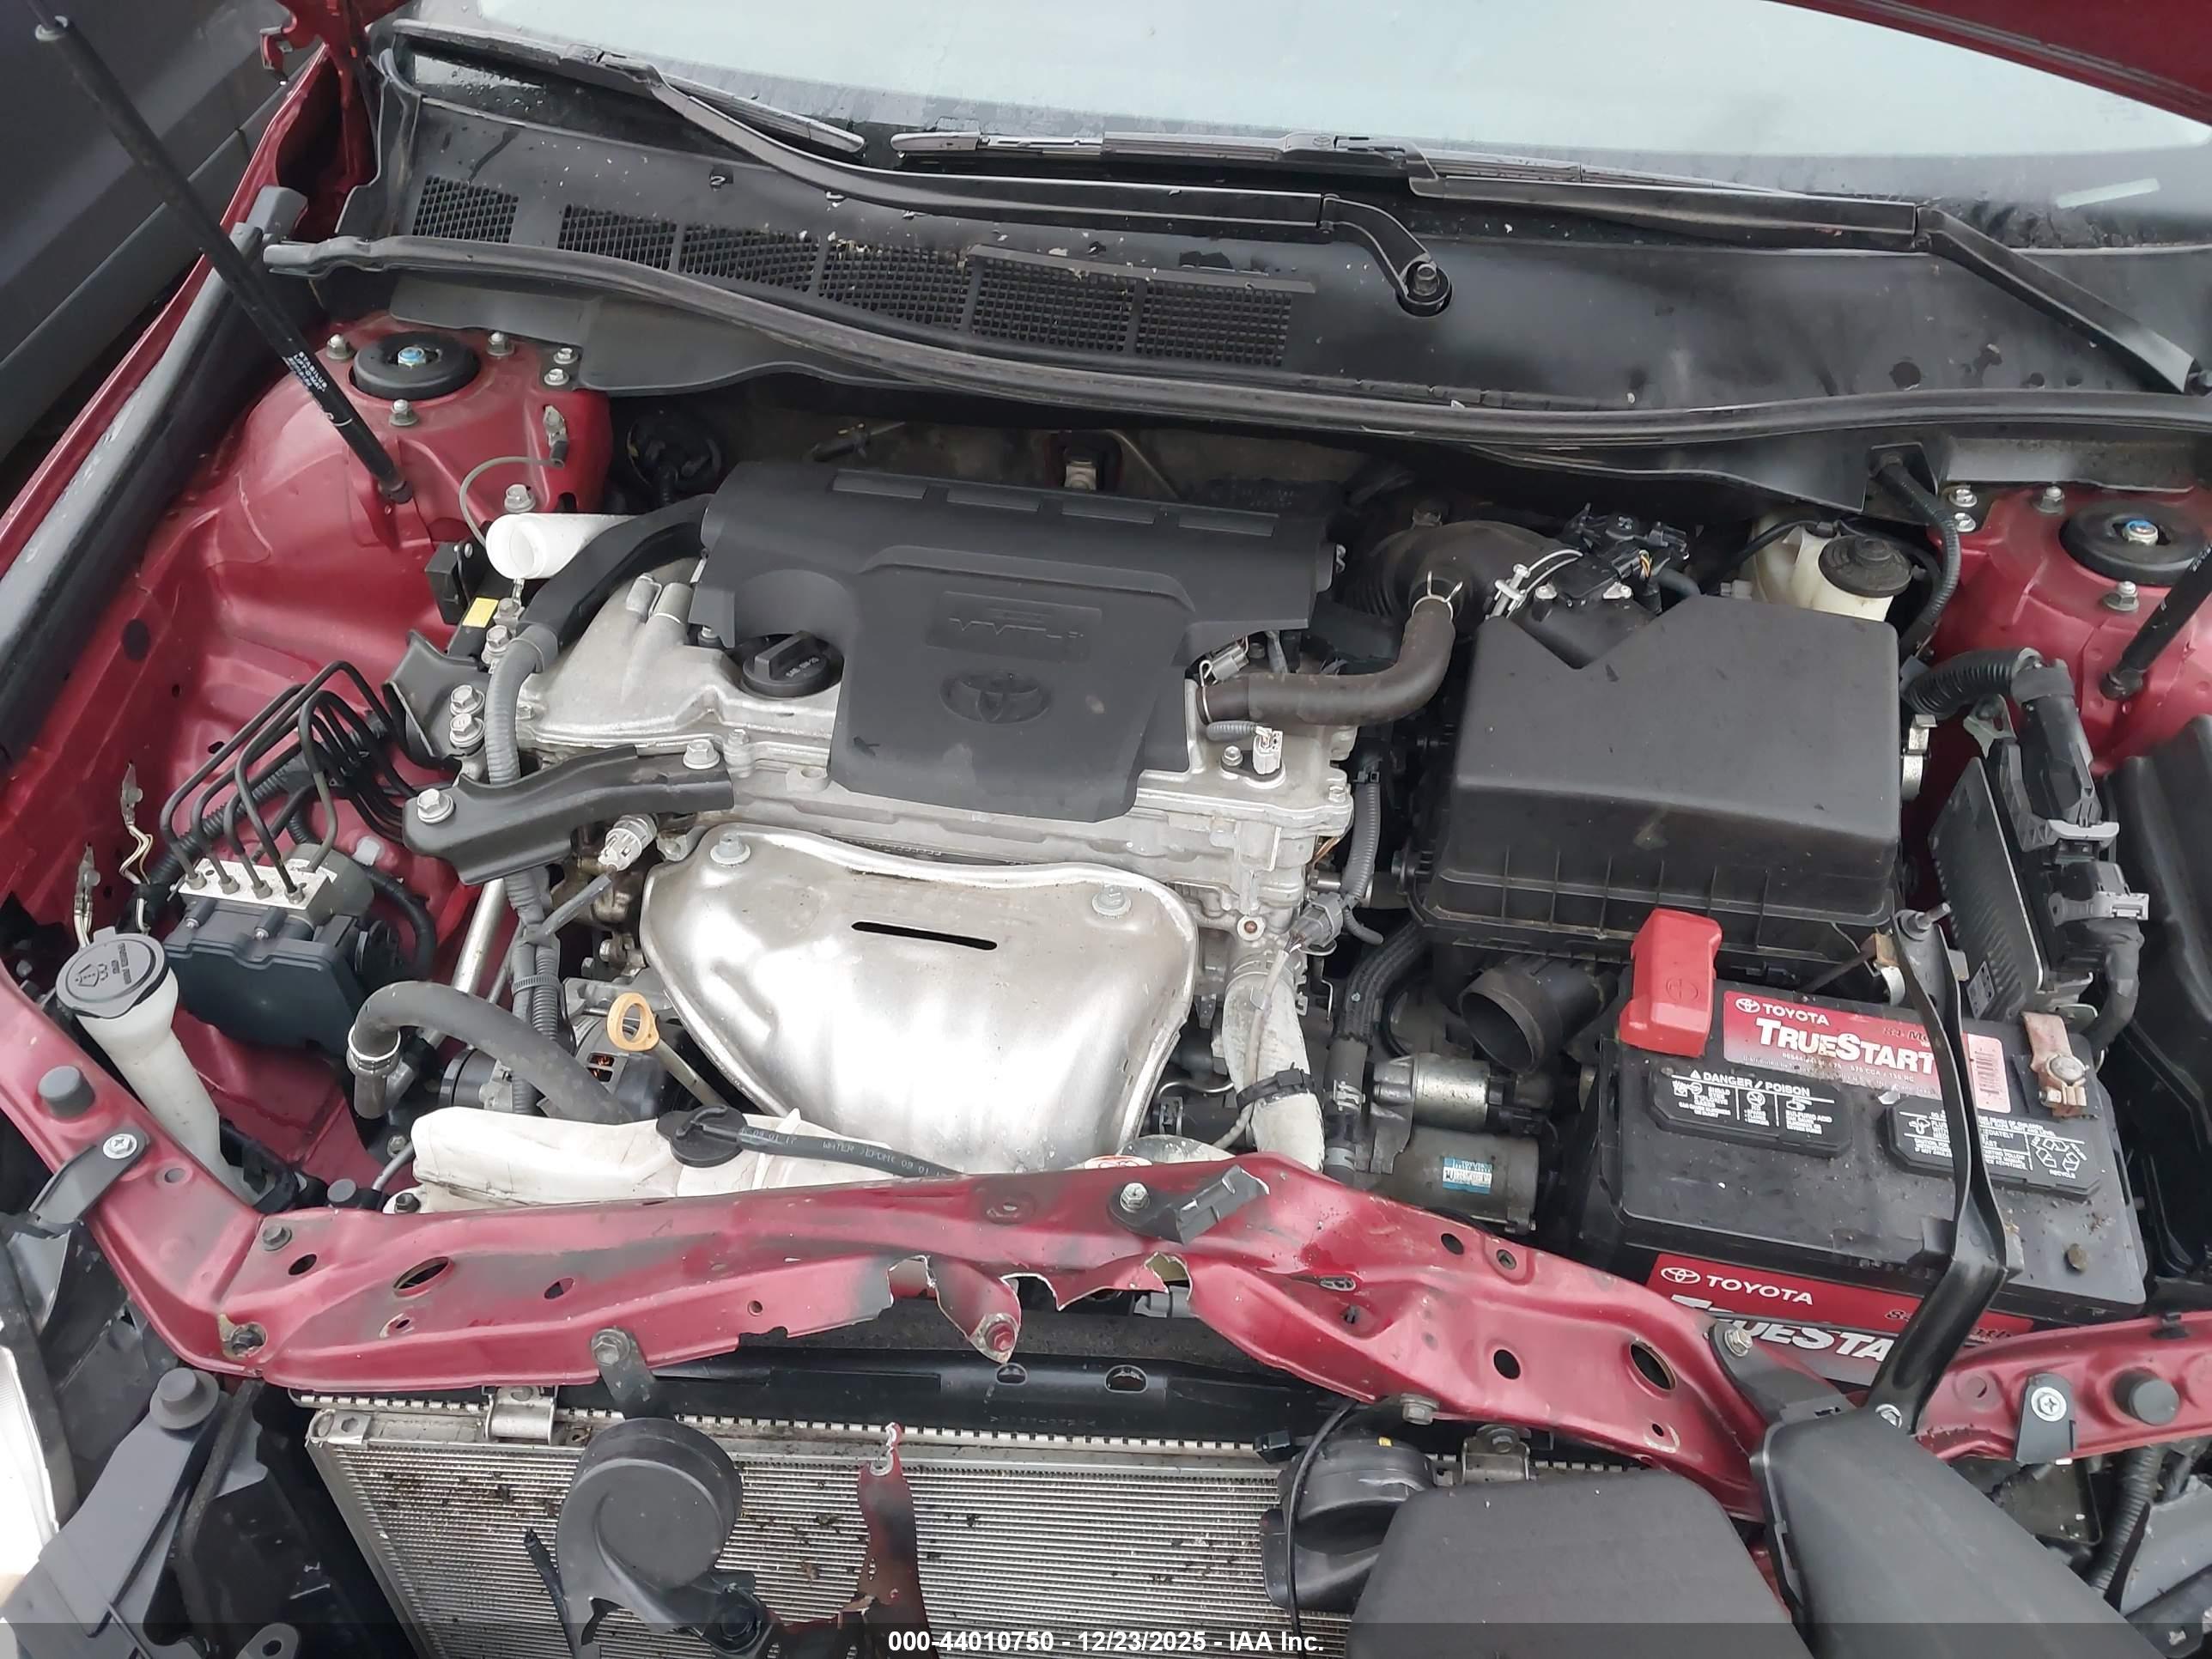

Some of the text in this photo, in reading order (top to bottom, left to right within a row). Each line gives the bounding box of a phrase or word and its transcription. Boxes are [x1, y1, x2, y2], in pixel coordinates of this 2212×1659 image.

[298, 350, 328, 389] STABILUS
[1762, 1003, 1830, 1026] TOYOTA
[1703, 1072, 1753, 1089] DANGER
[1765, 1081, 1810, 1097] POISON
[1706, 1274, 1814, 1306] TOYOTA
